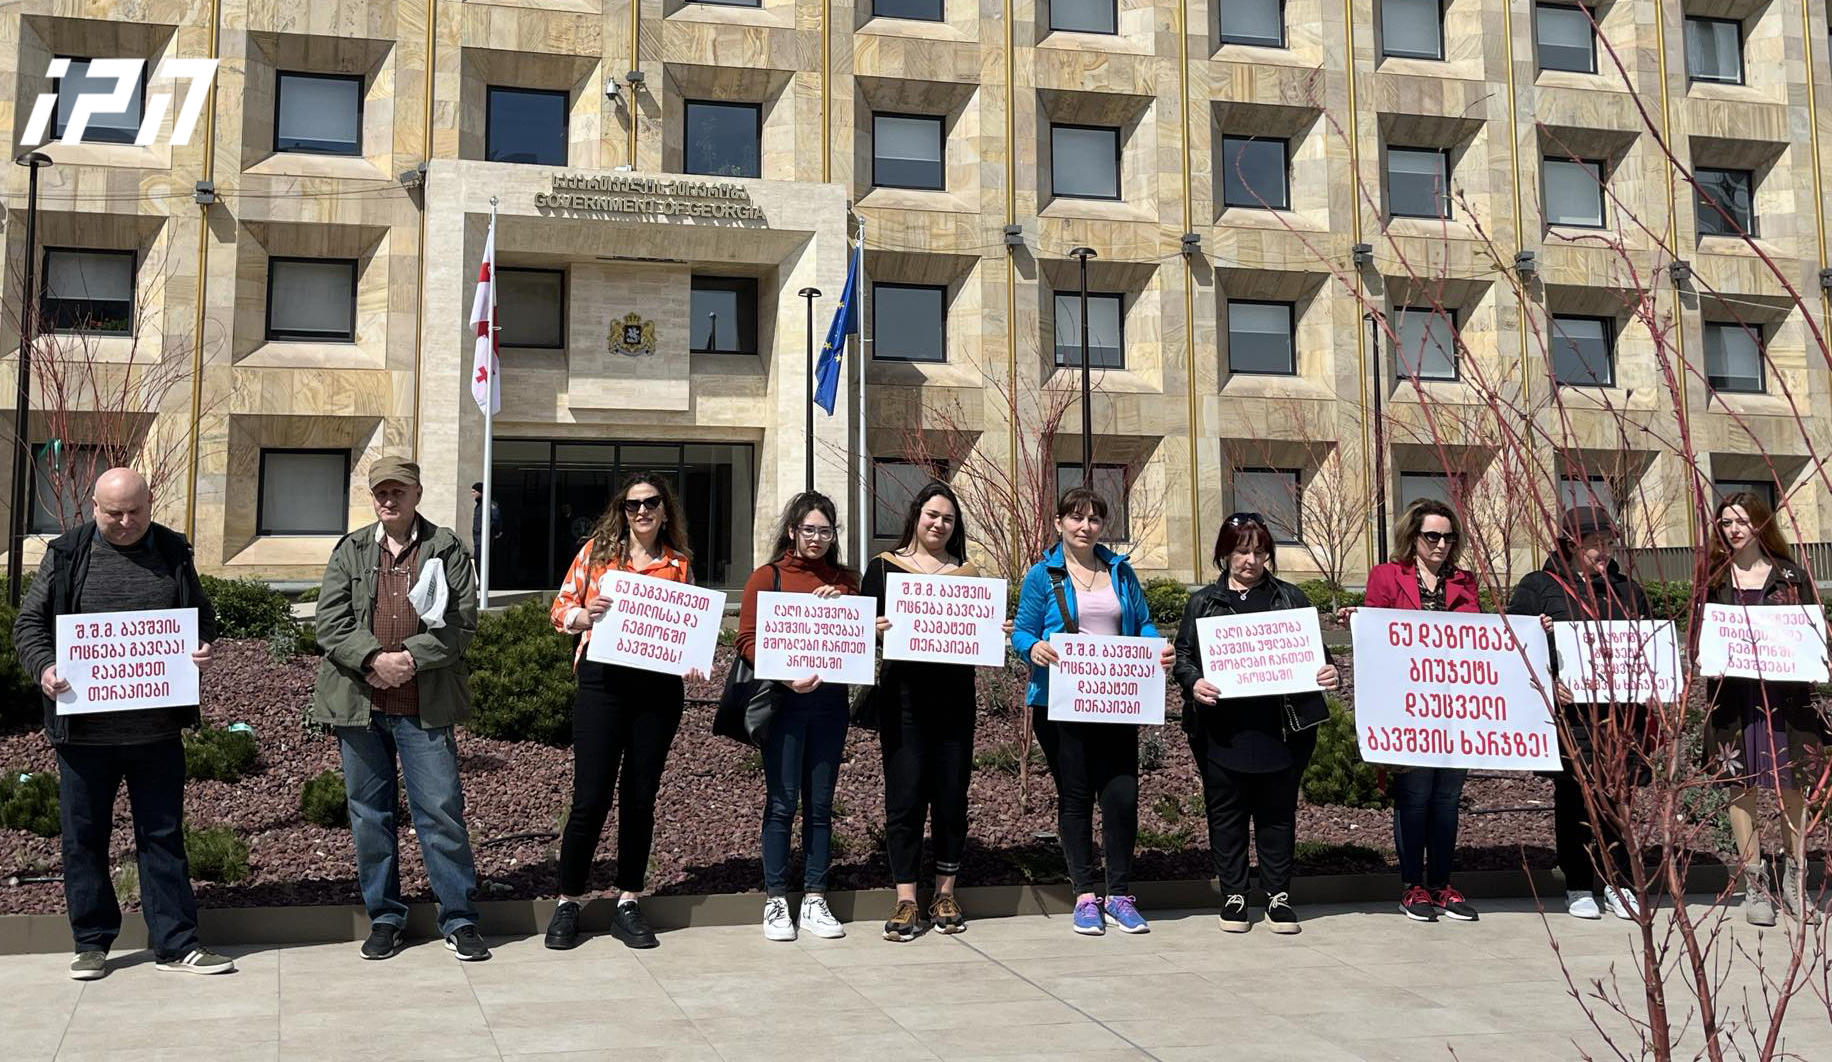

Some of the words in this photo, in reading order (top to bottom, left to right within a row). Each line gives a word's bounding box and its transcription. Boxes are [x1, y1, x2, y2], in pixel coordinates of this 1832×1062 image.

[534, 192, 654, 213] GOVERNMENT
[663, 199, 687, 215] OF
[688, 201, 767, 220] GEORGIA
[616, 580, 630, 593] ნუ
[633, 583, 709, 611] გაგვარჩევთ
[940, 584, 991, 599] ბავშვის
[618, 600, 680, 624] თბილისსა
[684, 614, 698, 628] და
[774, 605, 801, 617] ლაღი
[804, 606, 859, 620] ბავშვობა
[896, 600, 943, 615] ოცნება
[947, 603, 994, 618] გავლაა!
[121, 619, 180, 636] ბავშვის
[622, 619, 686, 645] რეგიონში
[765, 621, 811, 633] ბავშვის
[814, 623, 864, 637] უფლებაა!
[914, 619, 976, 635] დაამატეთ
[1389, 622, 1413, 647] ნუ
[70, 644, 125, 660] ოცნება
[130, 639, 185, 657] გავლაა!
[616, 638, 683, 664] ბავშვებს!
[763, 637, 819, 651] მშობლები
[822, 639, 865, 654] ჩართეთ
[910, 638, 979, 655] თერაპიები
[1103, 644, 1152, 659] ბავშვის
[92, 661, 165, 680] დაამატეთ
[787, 655, 842, 669] პროცესში
[1060, 662, 1106, 675] ოცნება
[1110, 663, 1154, 678] გავლაა!
[1410, 658, 1499, 685] ბიუჯეტს
[88, 681, 169, 701] თერაპიები
[1078, 680, 1138, 695] დაამატეთ
[1074, 699, 1140, 714] თერაპიები
[1405, 693, 1507, 720] დაუცველი
[1368, 727, 1454, 754] ბავშვის
[1461, 730, 1549, 757] ხარჯზე!
